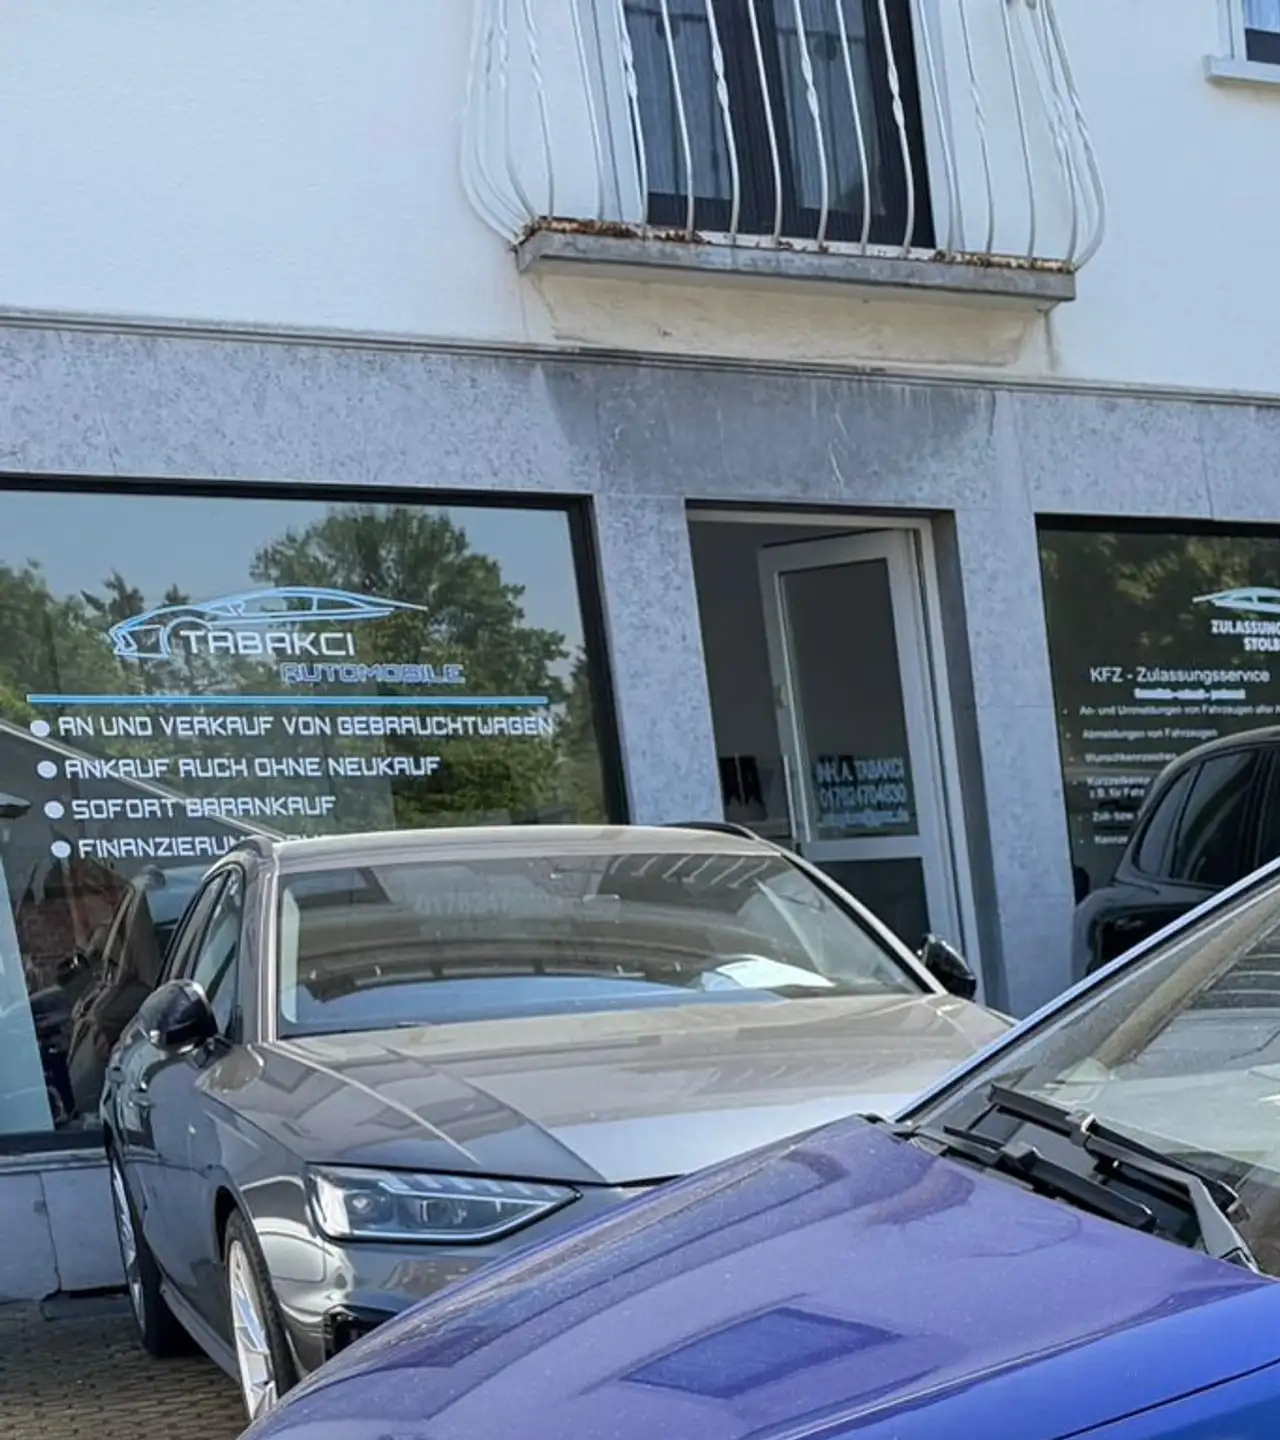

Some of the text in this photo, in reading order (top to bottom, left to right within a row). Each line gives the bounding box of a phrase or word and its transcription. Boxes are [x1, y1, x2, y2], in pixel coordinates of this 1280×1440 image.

[180, 630, 356, 655] TABAKCI
[280, 662, 466, 685] AUTOMOBILE
[1089, 666, 1124, 683] KFZ
[1136, 666, 1271, 686] Zulassungsservice
[58, 715, 553, 736] AN UND VERKAUF VON GEBRAUCHTWAGEN
[65, 756, 441, 779] ANKAUF AUCH OHNE NEUKAUF
[73, 796, 337, 820] SOFORT BARANKAUF
[79, 834, 246, 859] FINANZIERUN
